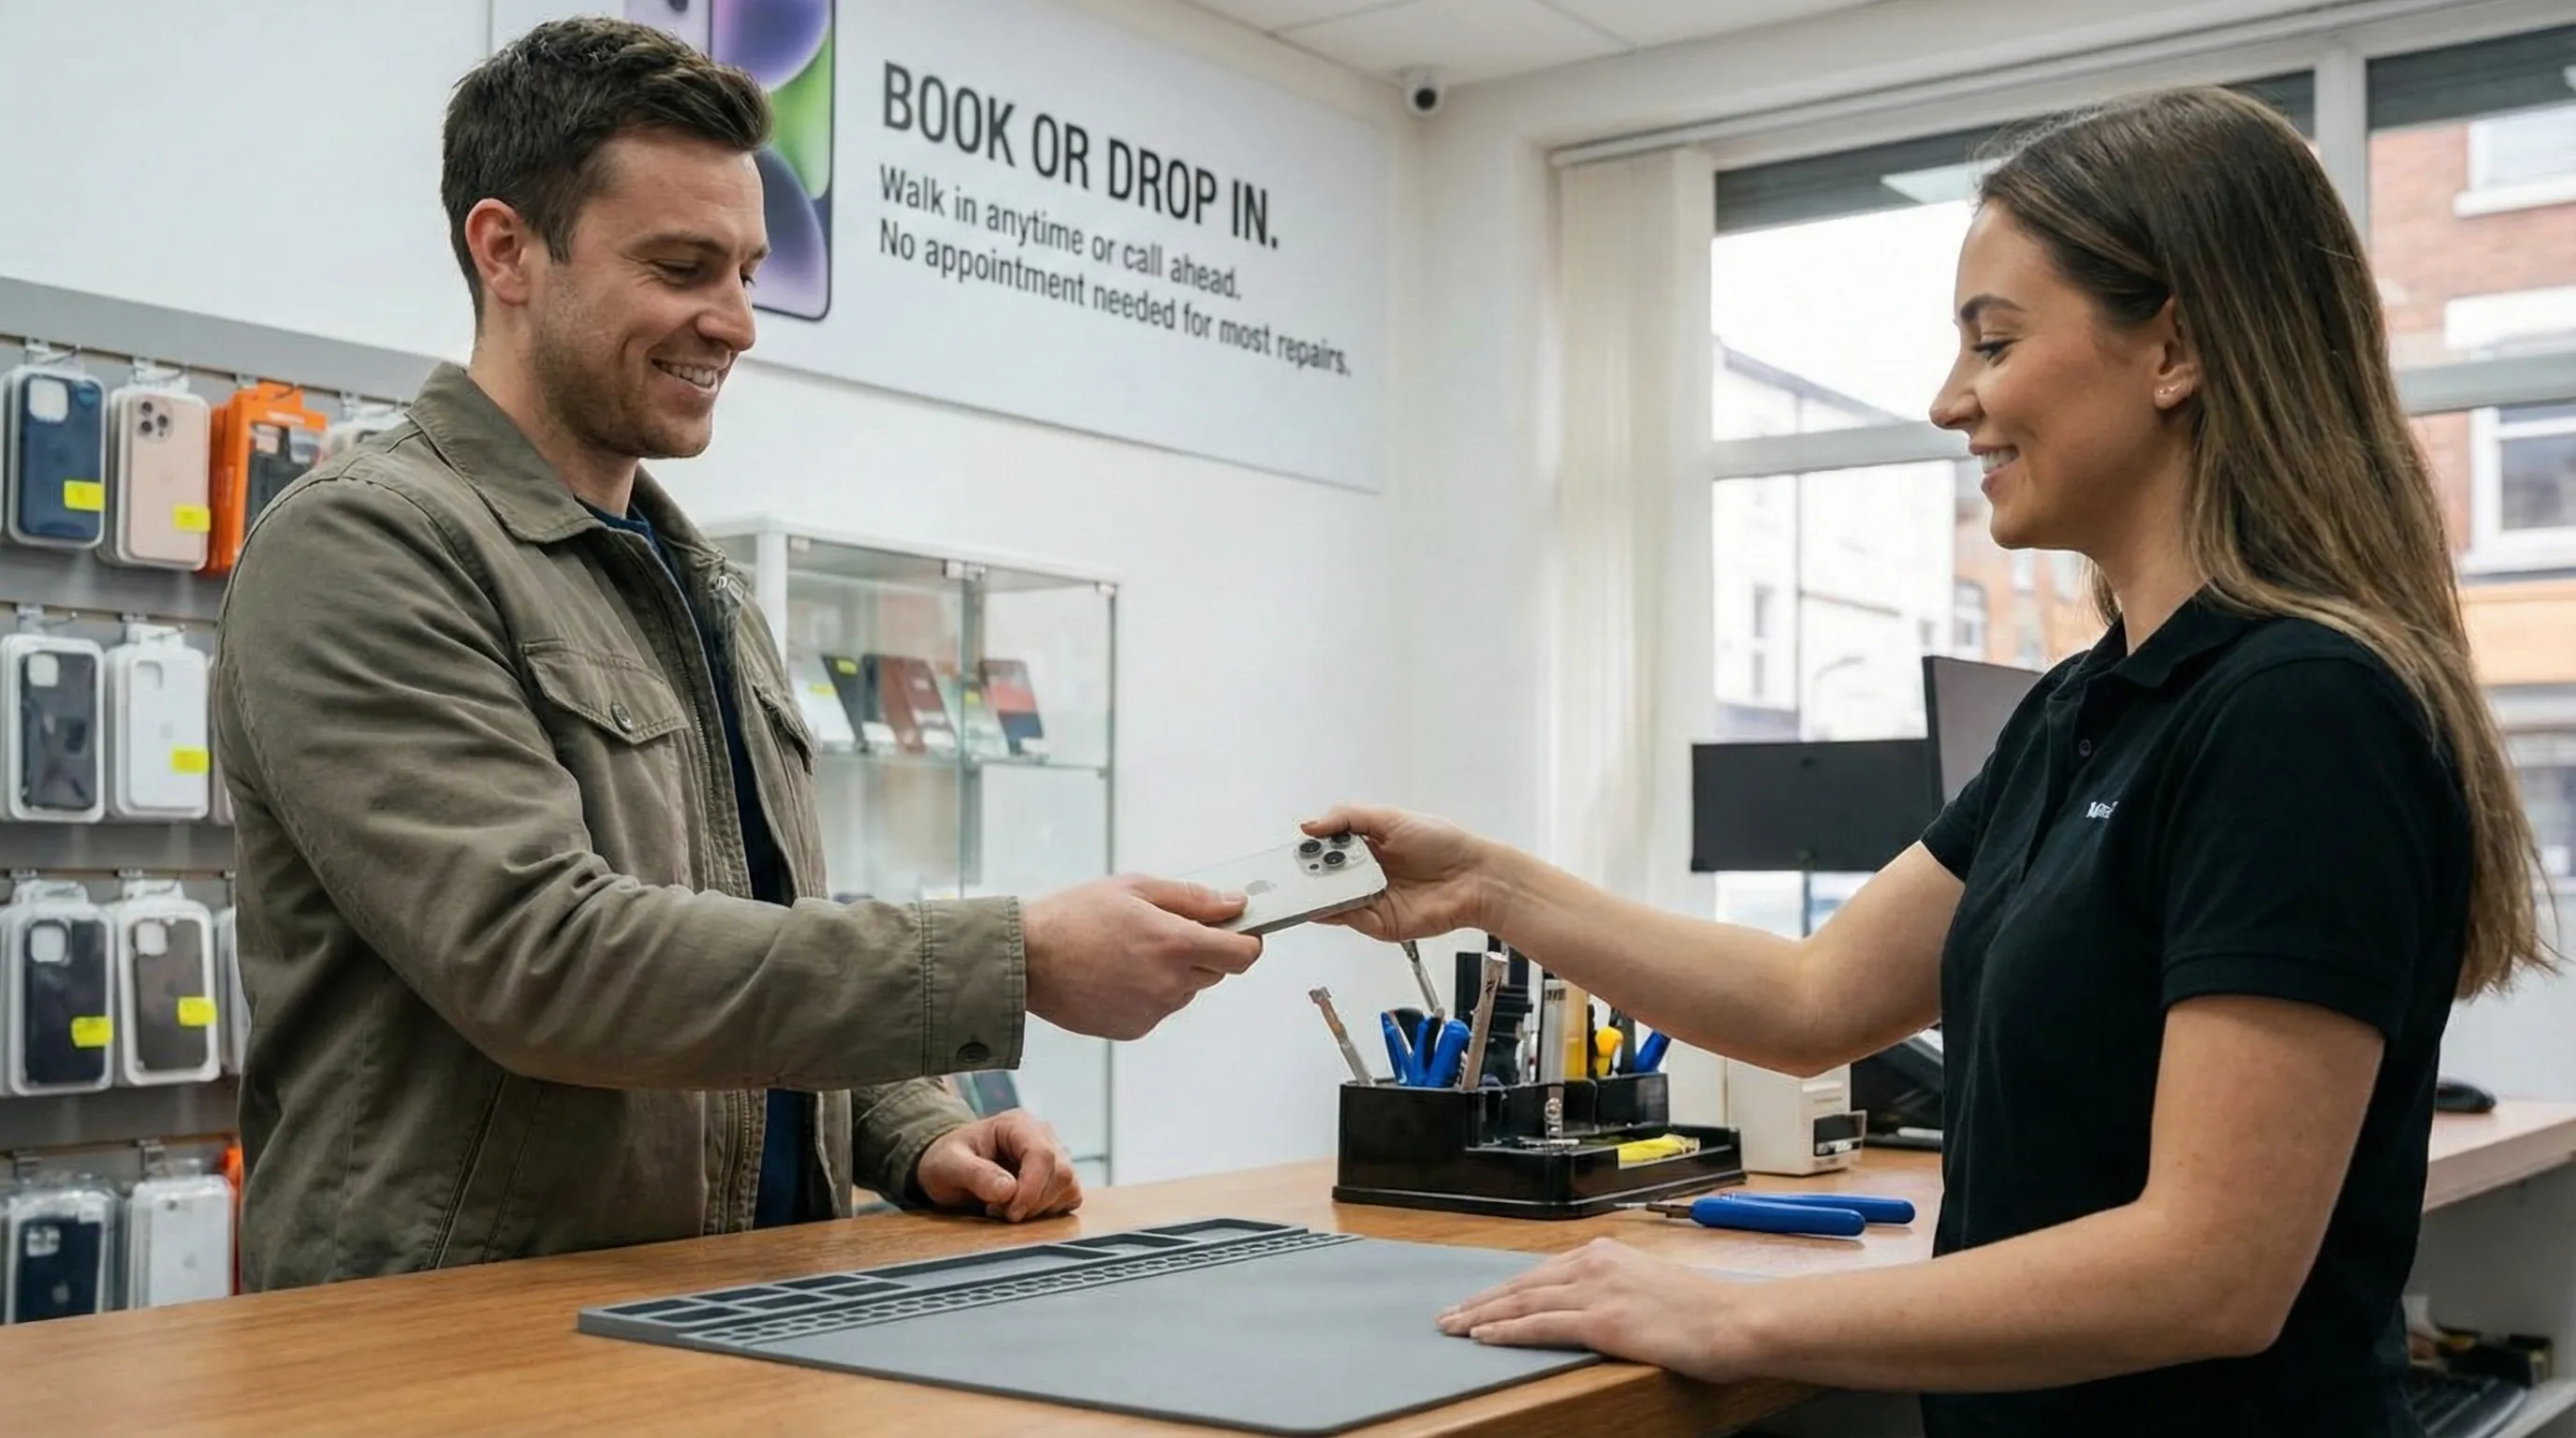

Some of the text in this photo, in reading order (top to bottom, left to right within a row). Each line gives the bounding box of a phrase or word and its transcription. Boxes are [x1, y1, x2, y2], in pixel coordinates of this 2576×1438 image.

[880, 164, 1242, 301] Walk in anytime or call ahead.
[883, 60, 1280, 250] BOOK OR DROP IN.
[880, 218, 1352, 376] No appointment needed for most repairs.
